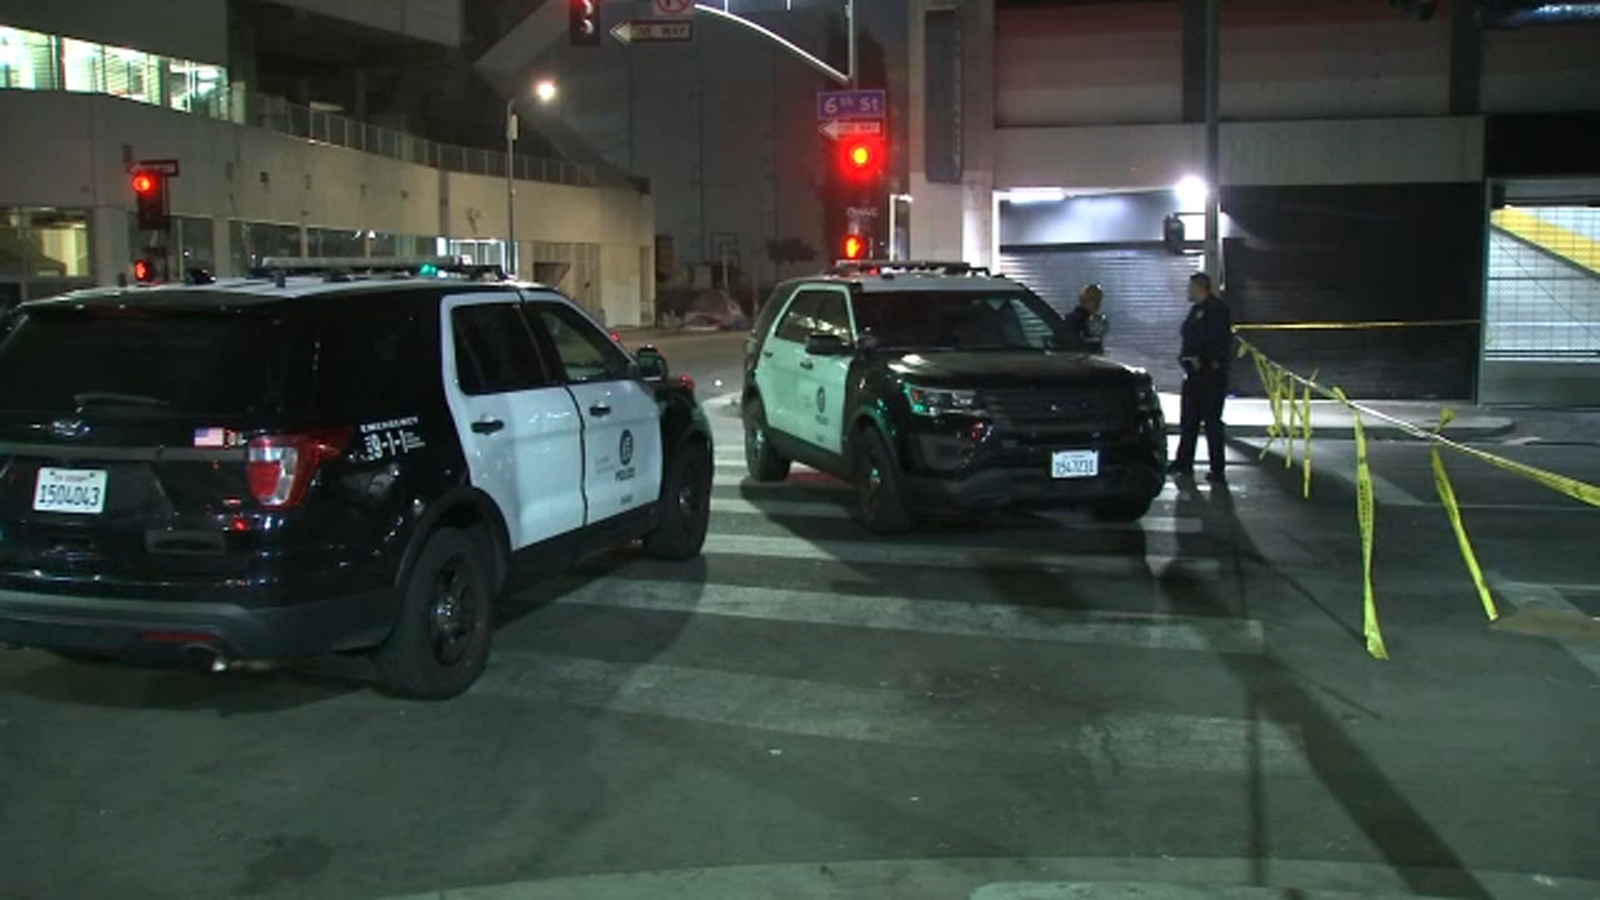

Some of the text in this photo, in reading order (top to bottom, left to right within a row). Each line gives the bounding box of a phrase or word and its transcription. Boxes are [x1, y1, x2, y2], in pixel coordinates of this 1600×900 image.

[824, 97, 879, 114] 6th St
[360, 416, 418, 433] EMERGENCY
[39, 484, 100, 506] 1504043
